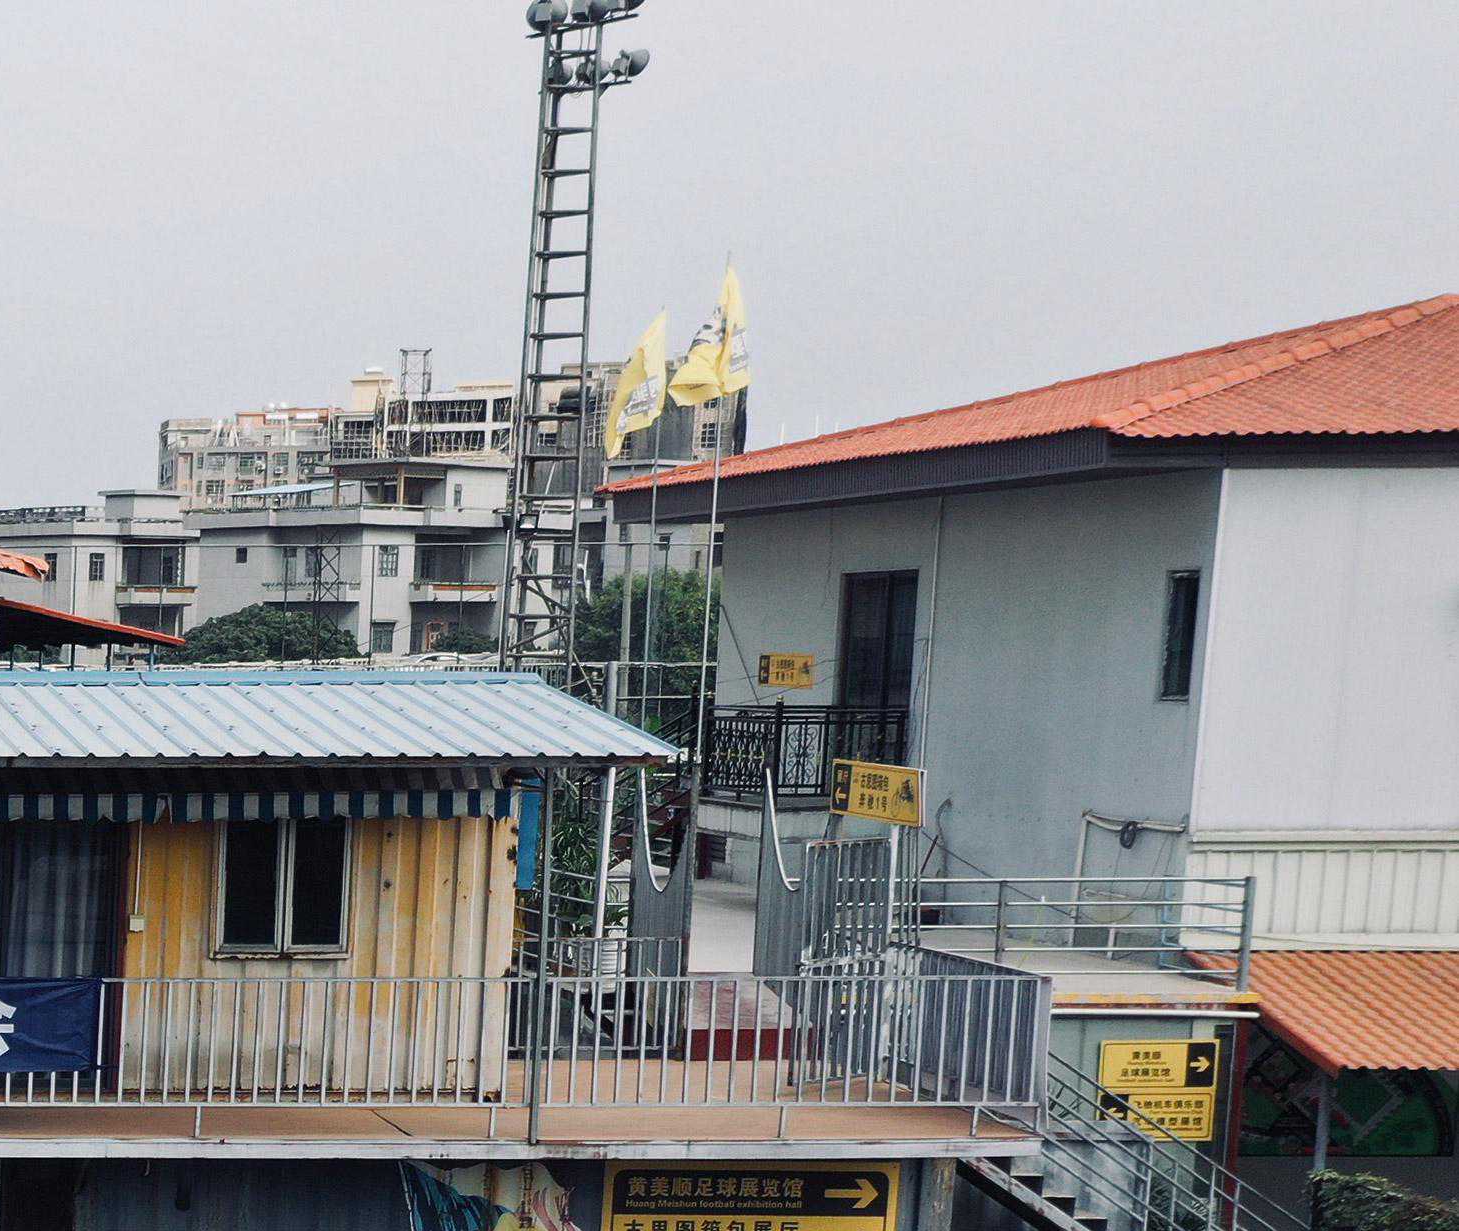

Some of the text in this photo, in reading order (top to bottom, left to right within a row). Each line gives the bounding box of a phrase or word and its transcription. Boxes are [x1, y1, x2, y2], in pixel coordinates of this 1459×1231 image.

[627, 1177, 804, 1199] 黄美顺足球展览馆
[626, 1200, 803, 1210] Huang Meishun football exhibition hall
